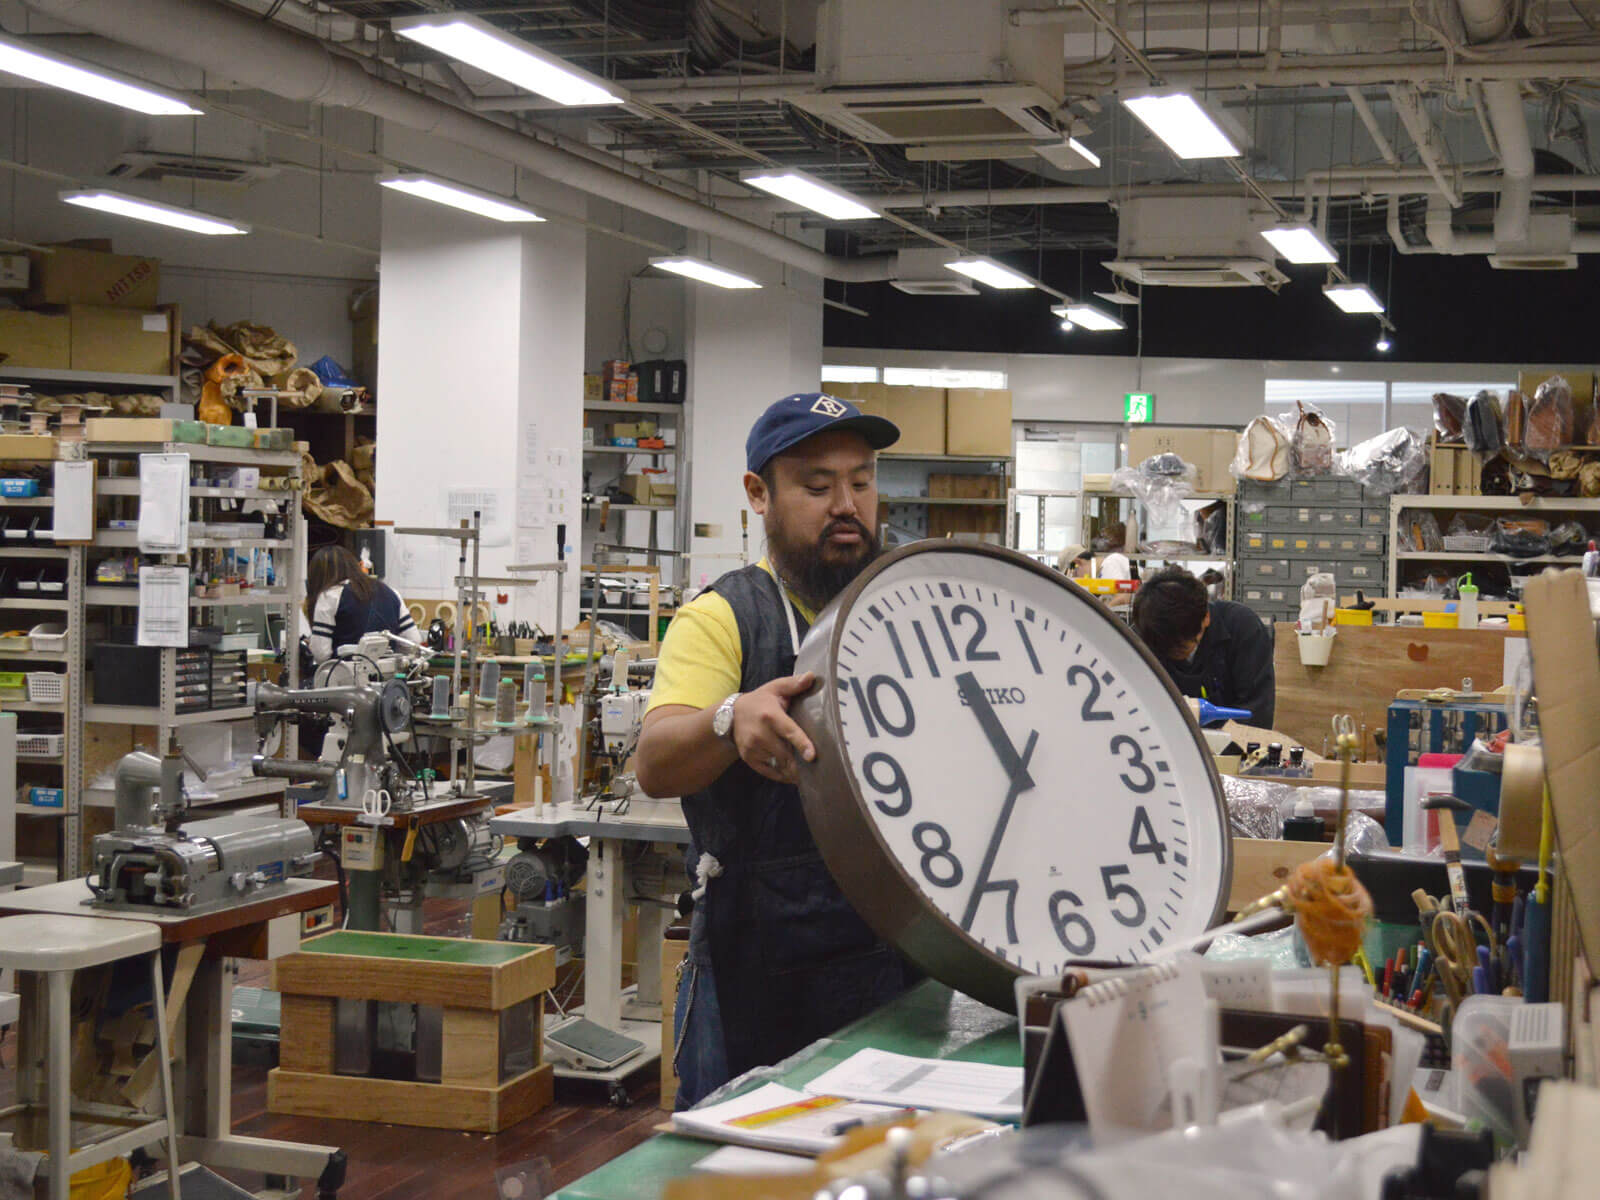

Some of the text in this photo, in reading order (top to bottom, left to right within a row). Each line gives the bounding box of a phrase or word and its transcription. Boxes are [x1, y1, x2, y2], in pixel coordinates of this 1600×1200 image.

[884, 620, 941, 678] 11
[931, 604, 1000, 662] 12
[1015, 619, 1044, 675] 1
[849, 674, 916, 738] 10
[957, 687, 1025, 706] SIKO
[1066, 664, 1115, 722] 2
[862, 751, 913, 818] 9
[1109, 734, 1156, 794] 3
[911, 821, 964, 889] 8
[1128, 805, 1168, 865] 4
[980, 878, 1019, 944] 7
[1048, 889, 1096, 957] 6
[1099, 863, 1147, 928] 5
